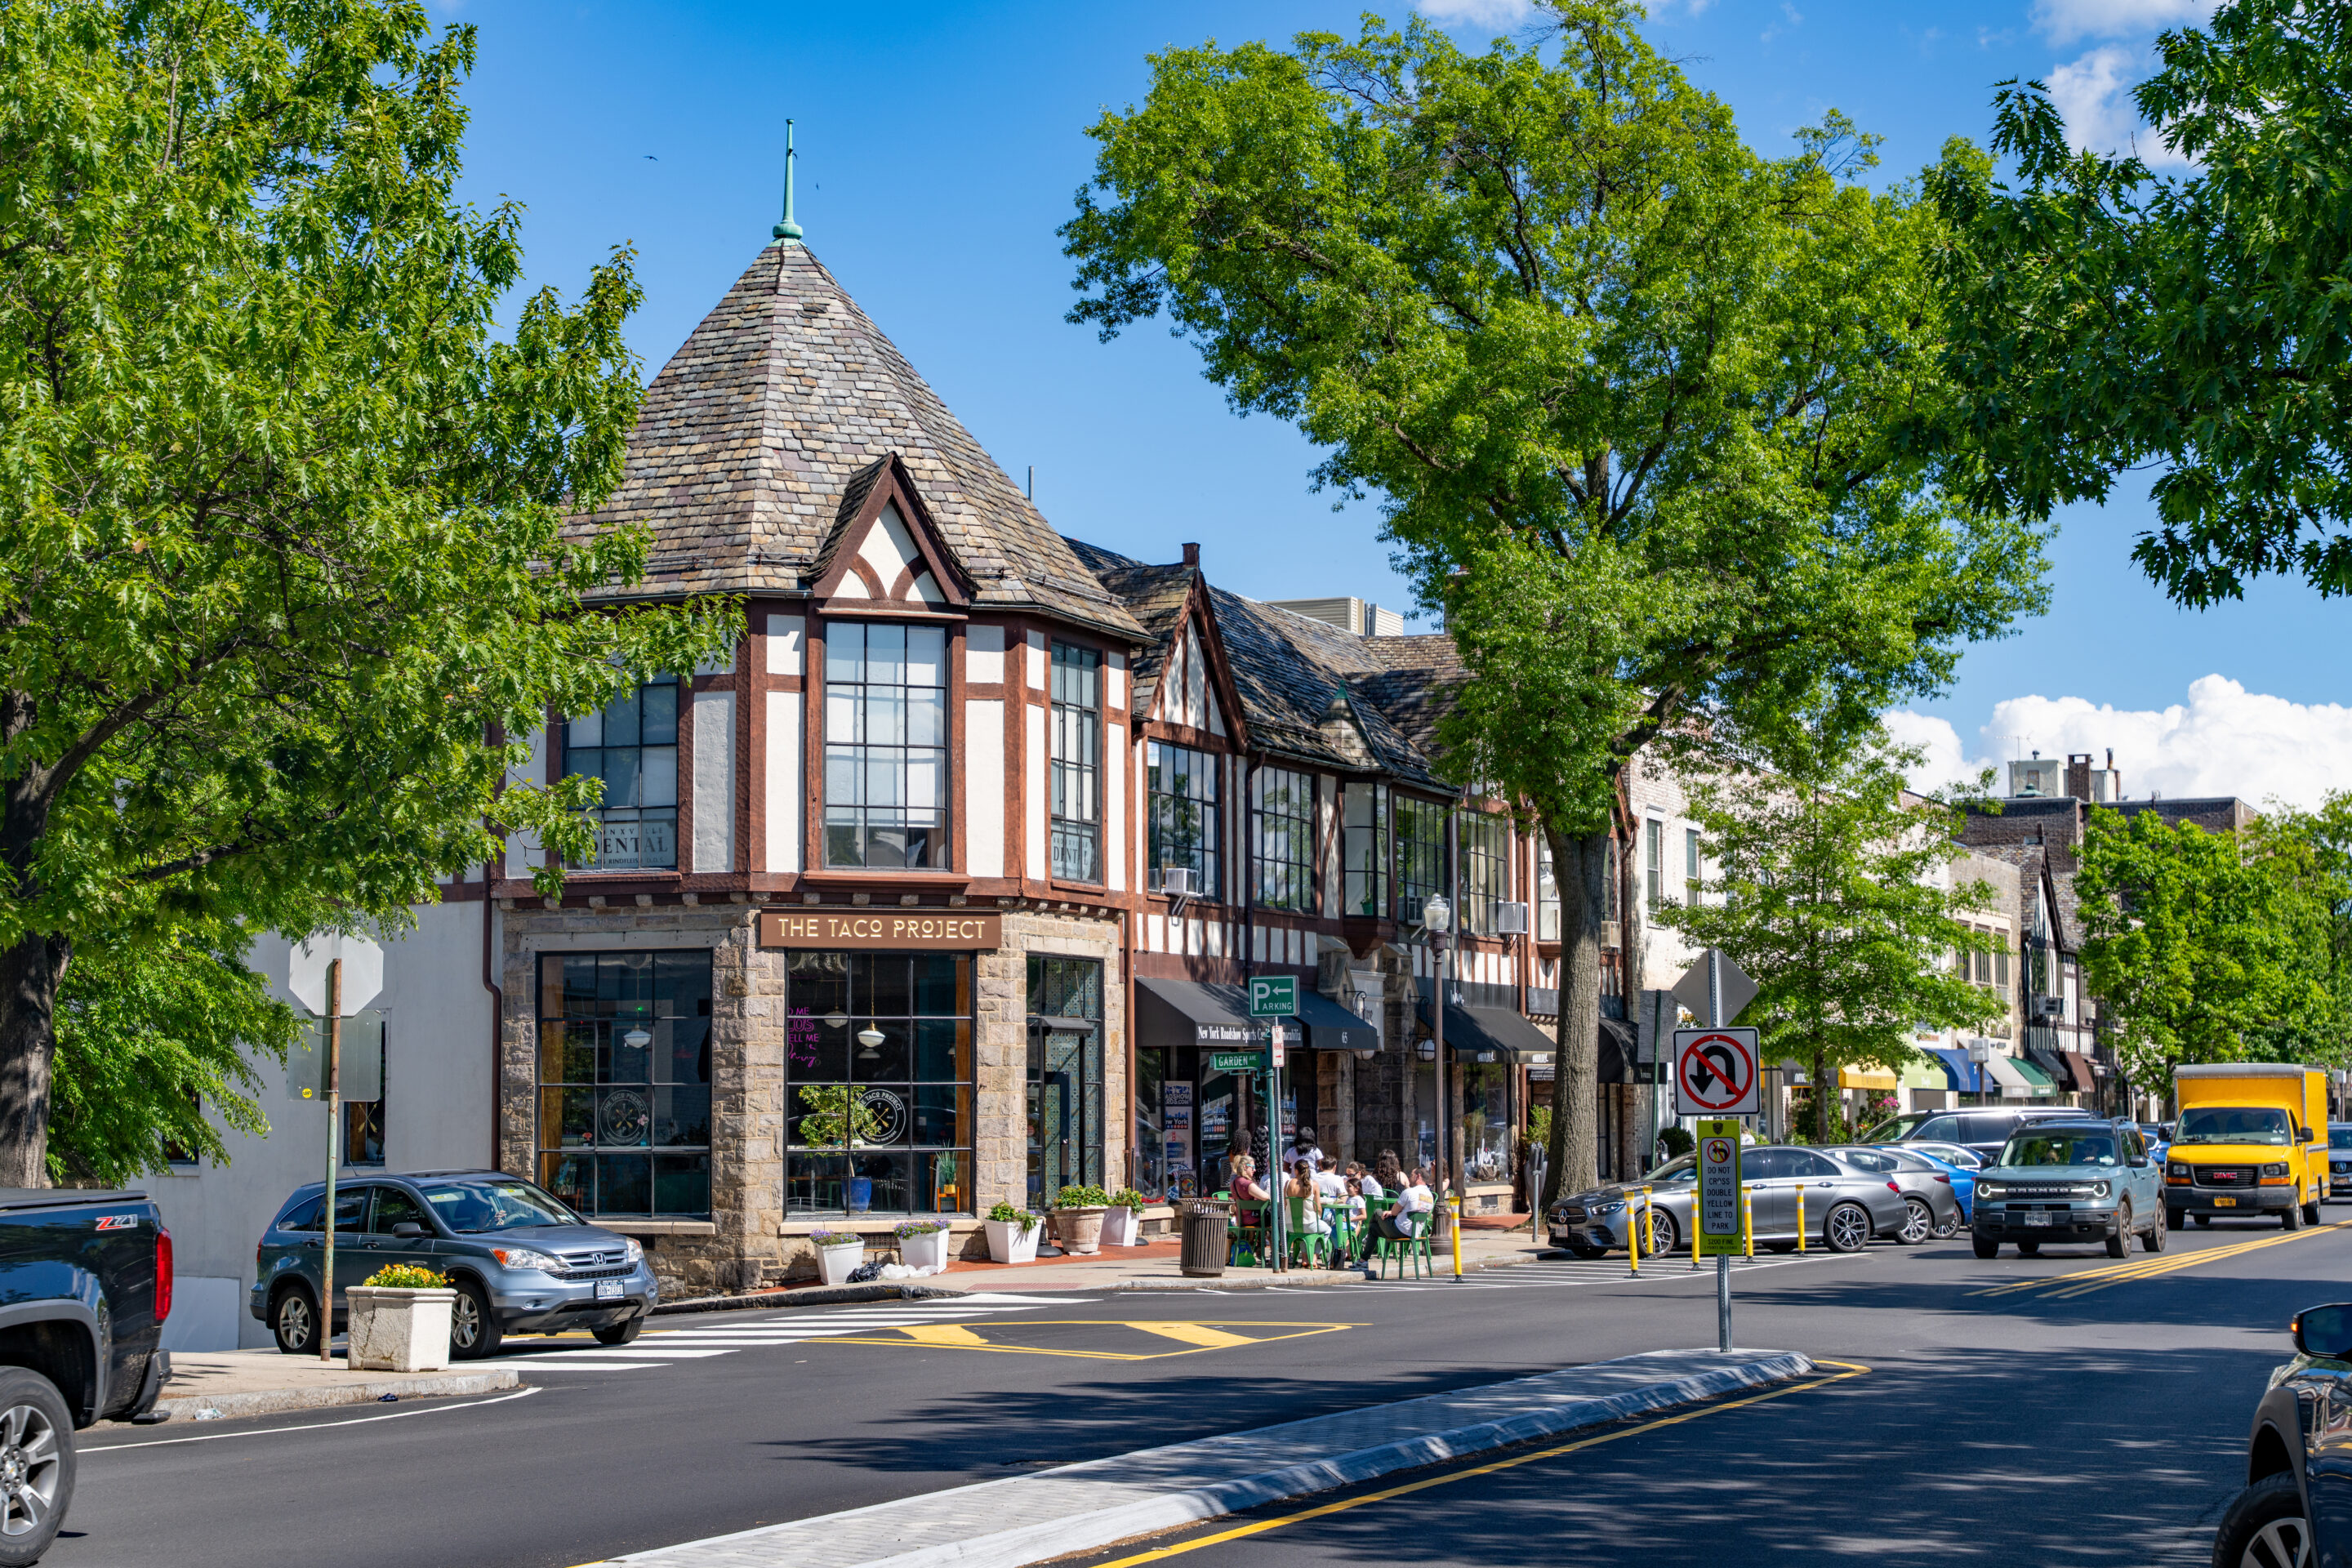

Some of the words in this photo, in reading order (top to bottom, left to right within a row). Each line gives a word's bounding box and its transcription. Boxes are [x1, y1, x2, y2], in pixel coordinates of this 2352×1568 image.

[778, 918, 819, 938] THE
[828, 919, 883, 938] TACO
[893, 919, 986, 939] PROJECT
[789, 1033, 803, 1043] ELL
[1198, 1026, 1208, 1040] New
[1209, 1026, 1219, 1040] York
[1220, 1027, 1241, 1040] Roadshow
[1242, 1027, 1257, 1043] Sports
[1342, 1031, 1348, 1044] 65
[1218, 1055, 1248, 1067] GARDEN
[881, 1092, 902, 1111] PROJECT
[1708, 1166, 1717, 1174] DO
[1717, 1166, 1731, 1174] NOT
[1708, 1178, 1731, 1186] CROSS
[1707, 1188, 1732, 1196] DOUBLE
[1707, 1200, 1733, 1208] YELLOW
[95, 1214, 138, 1232] Z71
[1711, 1222, 1729, 1230] PARK
